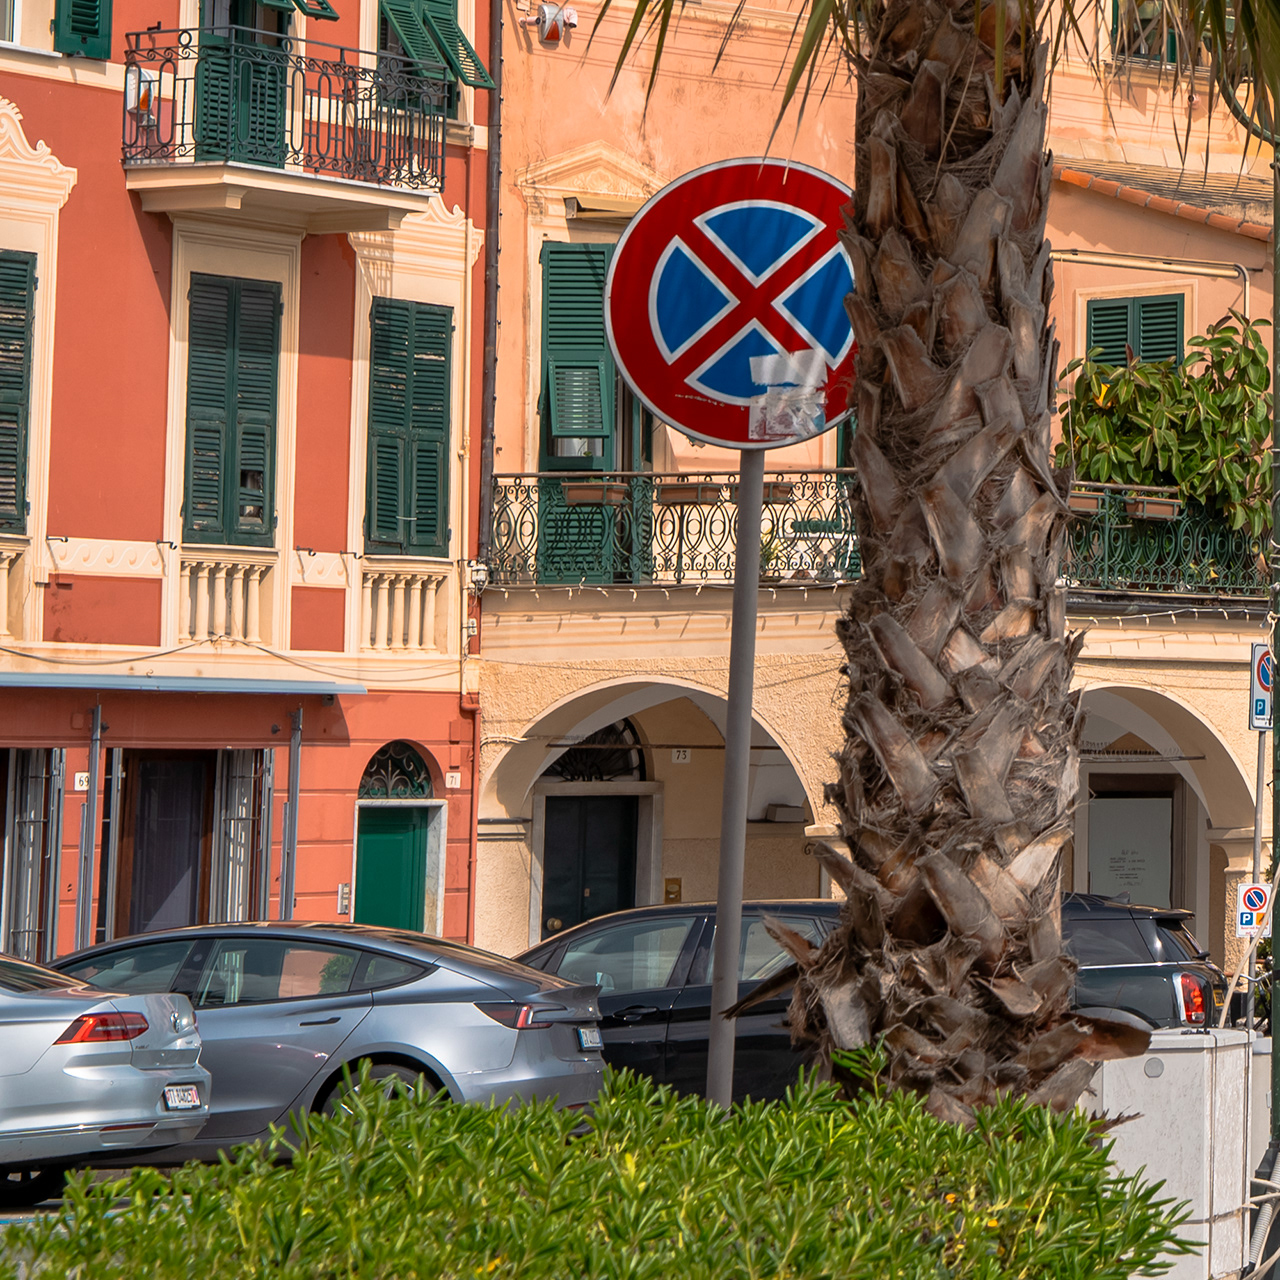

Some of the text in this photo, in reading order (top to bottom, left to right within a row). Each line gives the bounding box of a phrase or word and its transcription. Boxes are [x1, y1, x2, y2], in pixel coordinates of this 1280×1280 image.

[1256, 701, 1264, 714] P
[676, 750, 687, 760] 73
[78, 775, 90, 787] 69
[450, 775, 457, 786] 71
[1242, 914, 1251, 924] P
